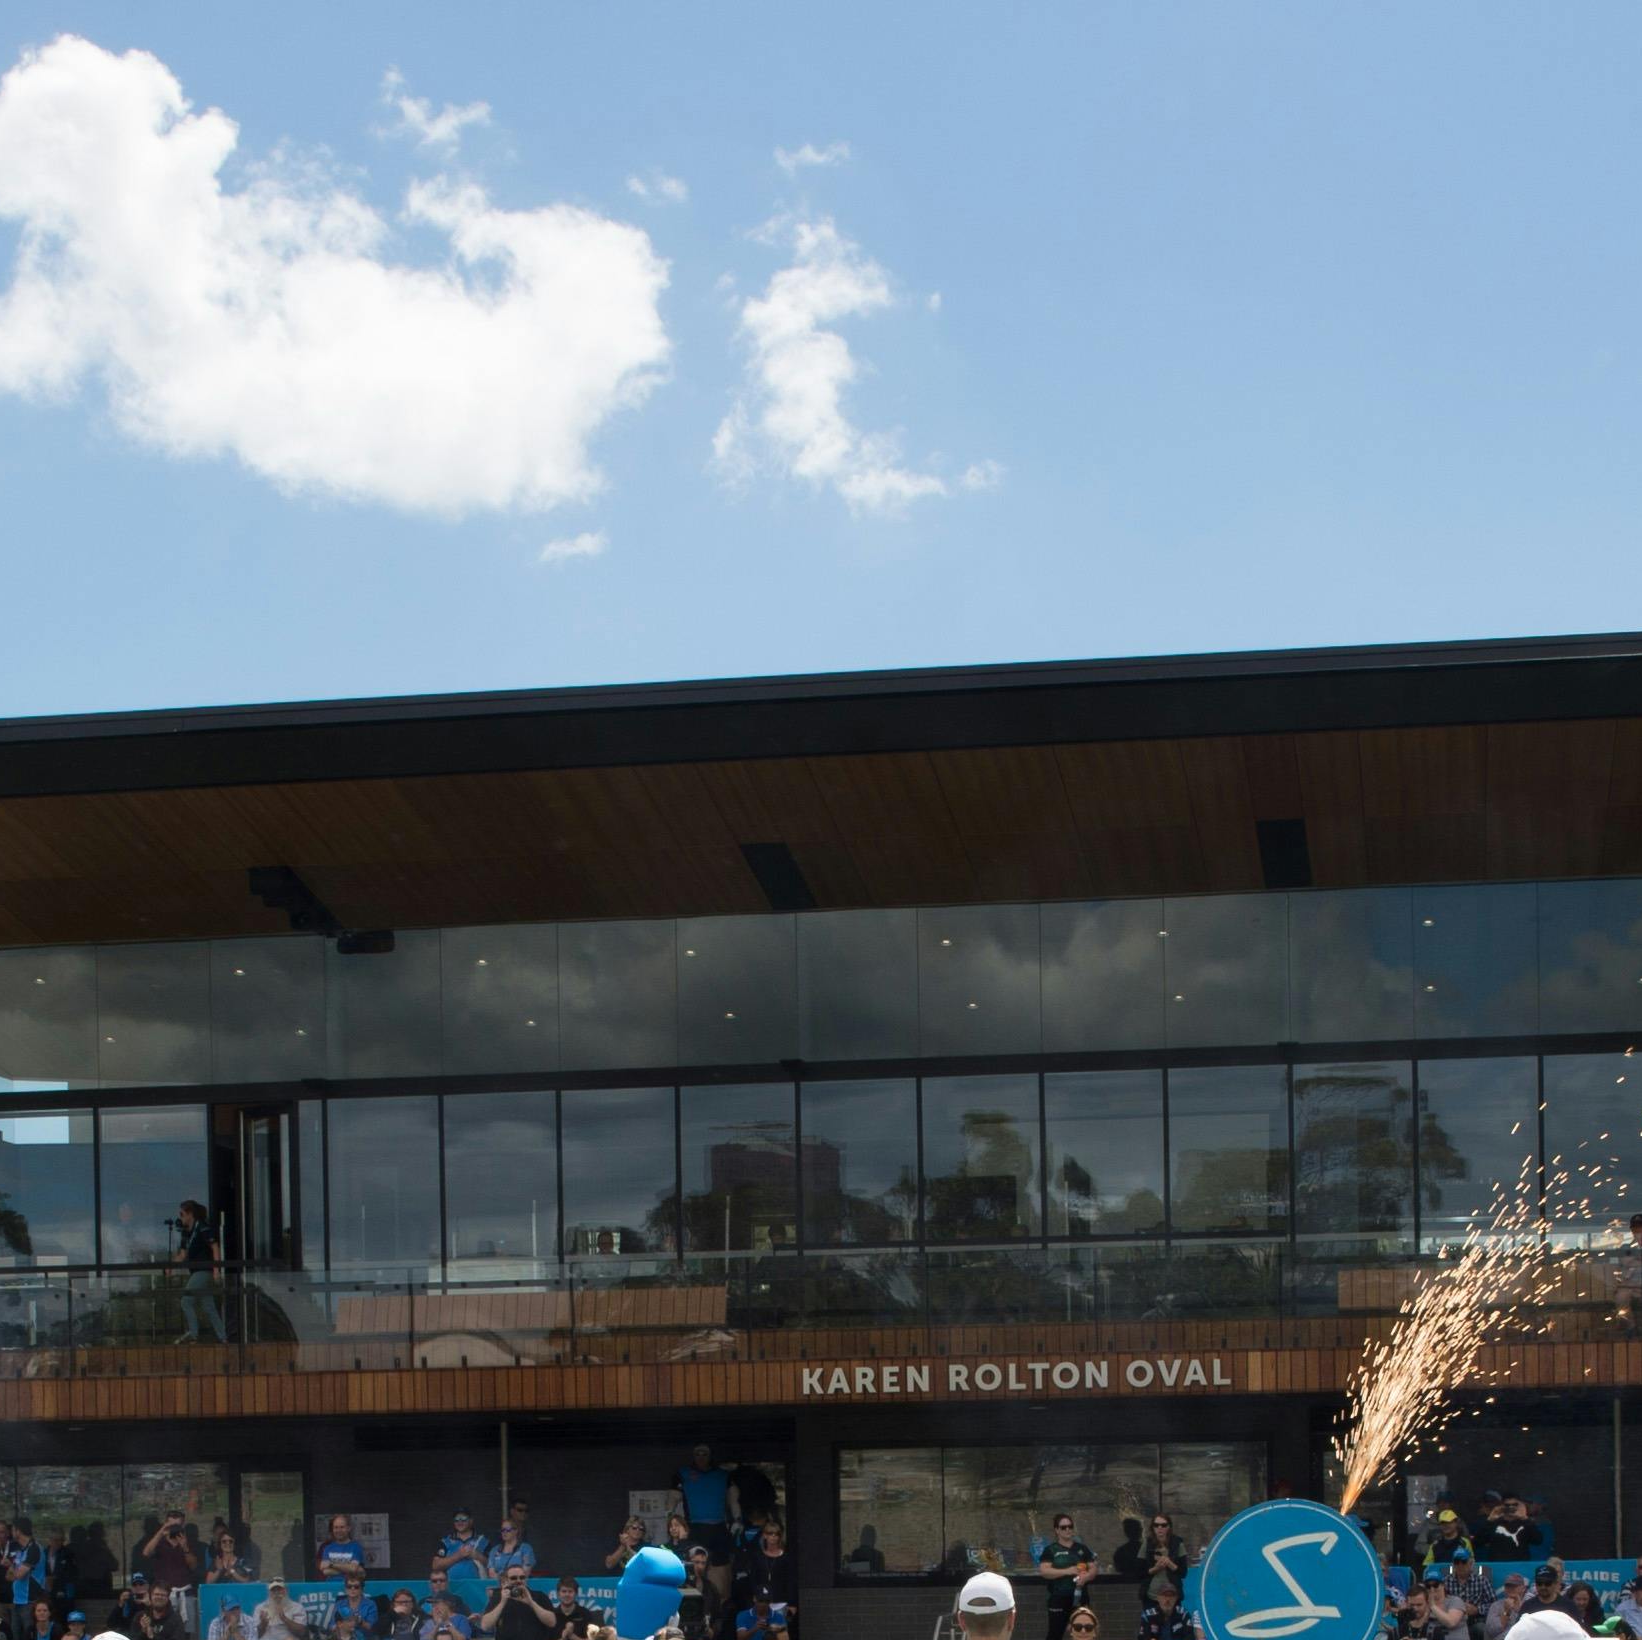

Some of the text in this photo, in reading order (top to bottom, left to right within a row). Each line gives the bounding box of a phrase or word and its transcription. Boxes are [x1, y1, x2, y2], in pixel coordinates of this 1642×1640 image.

[801, 1357, 1232, 1395] KAREN ROLTON OVAL
[1561, 1570, 1621, 1583] ELAIDE
